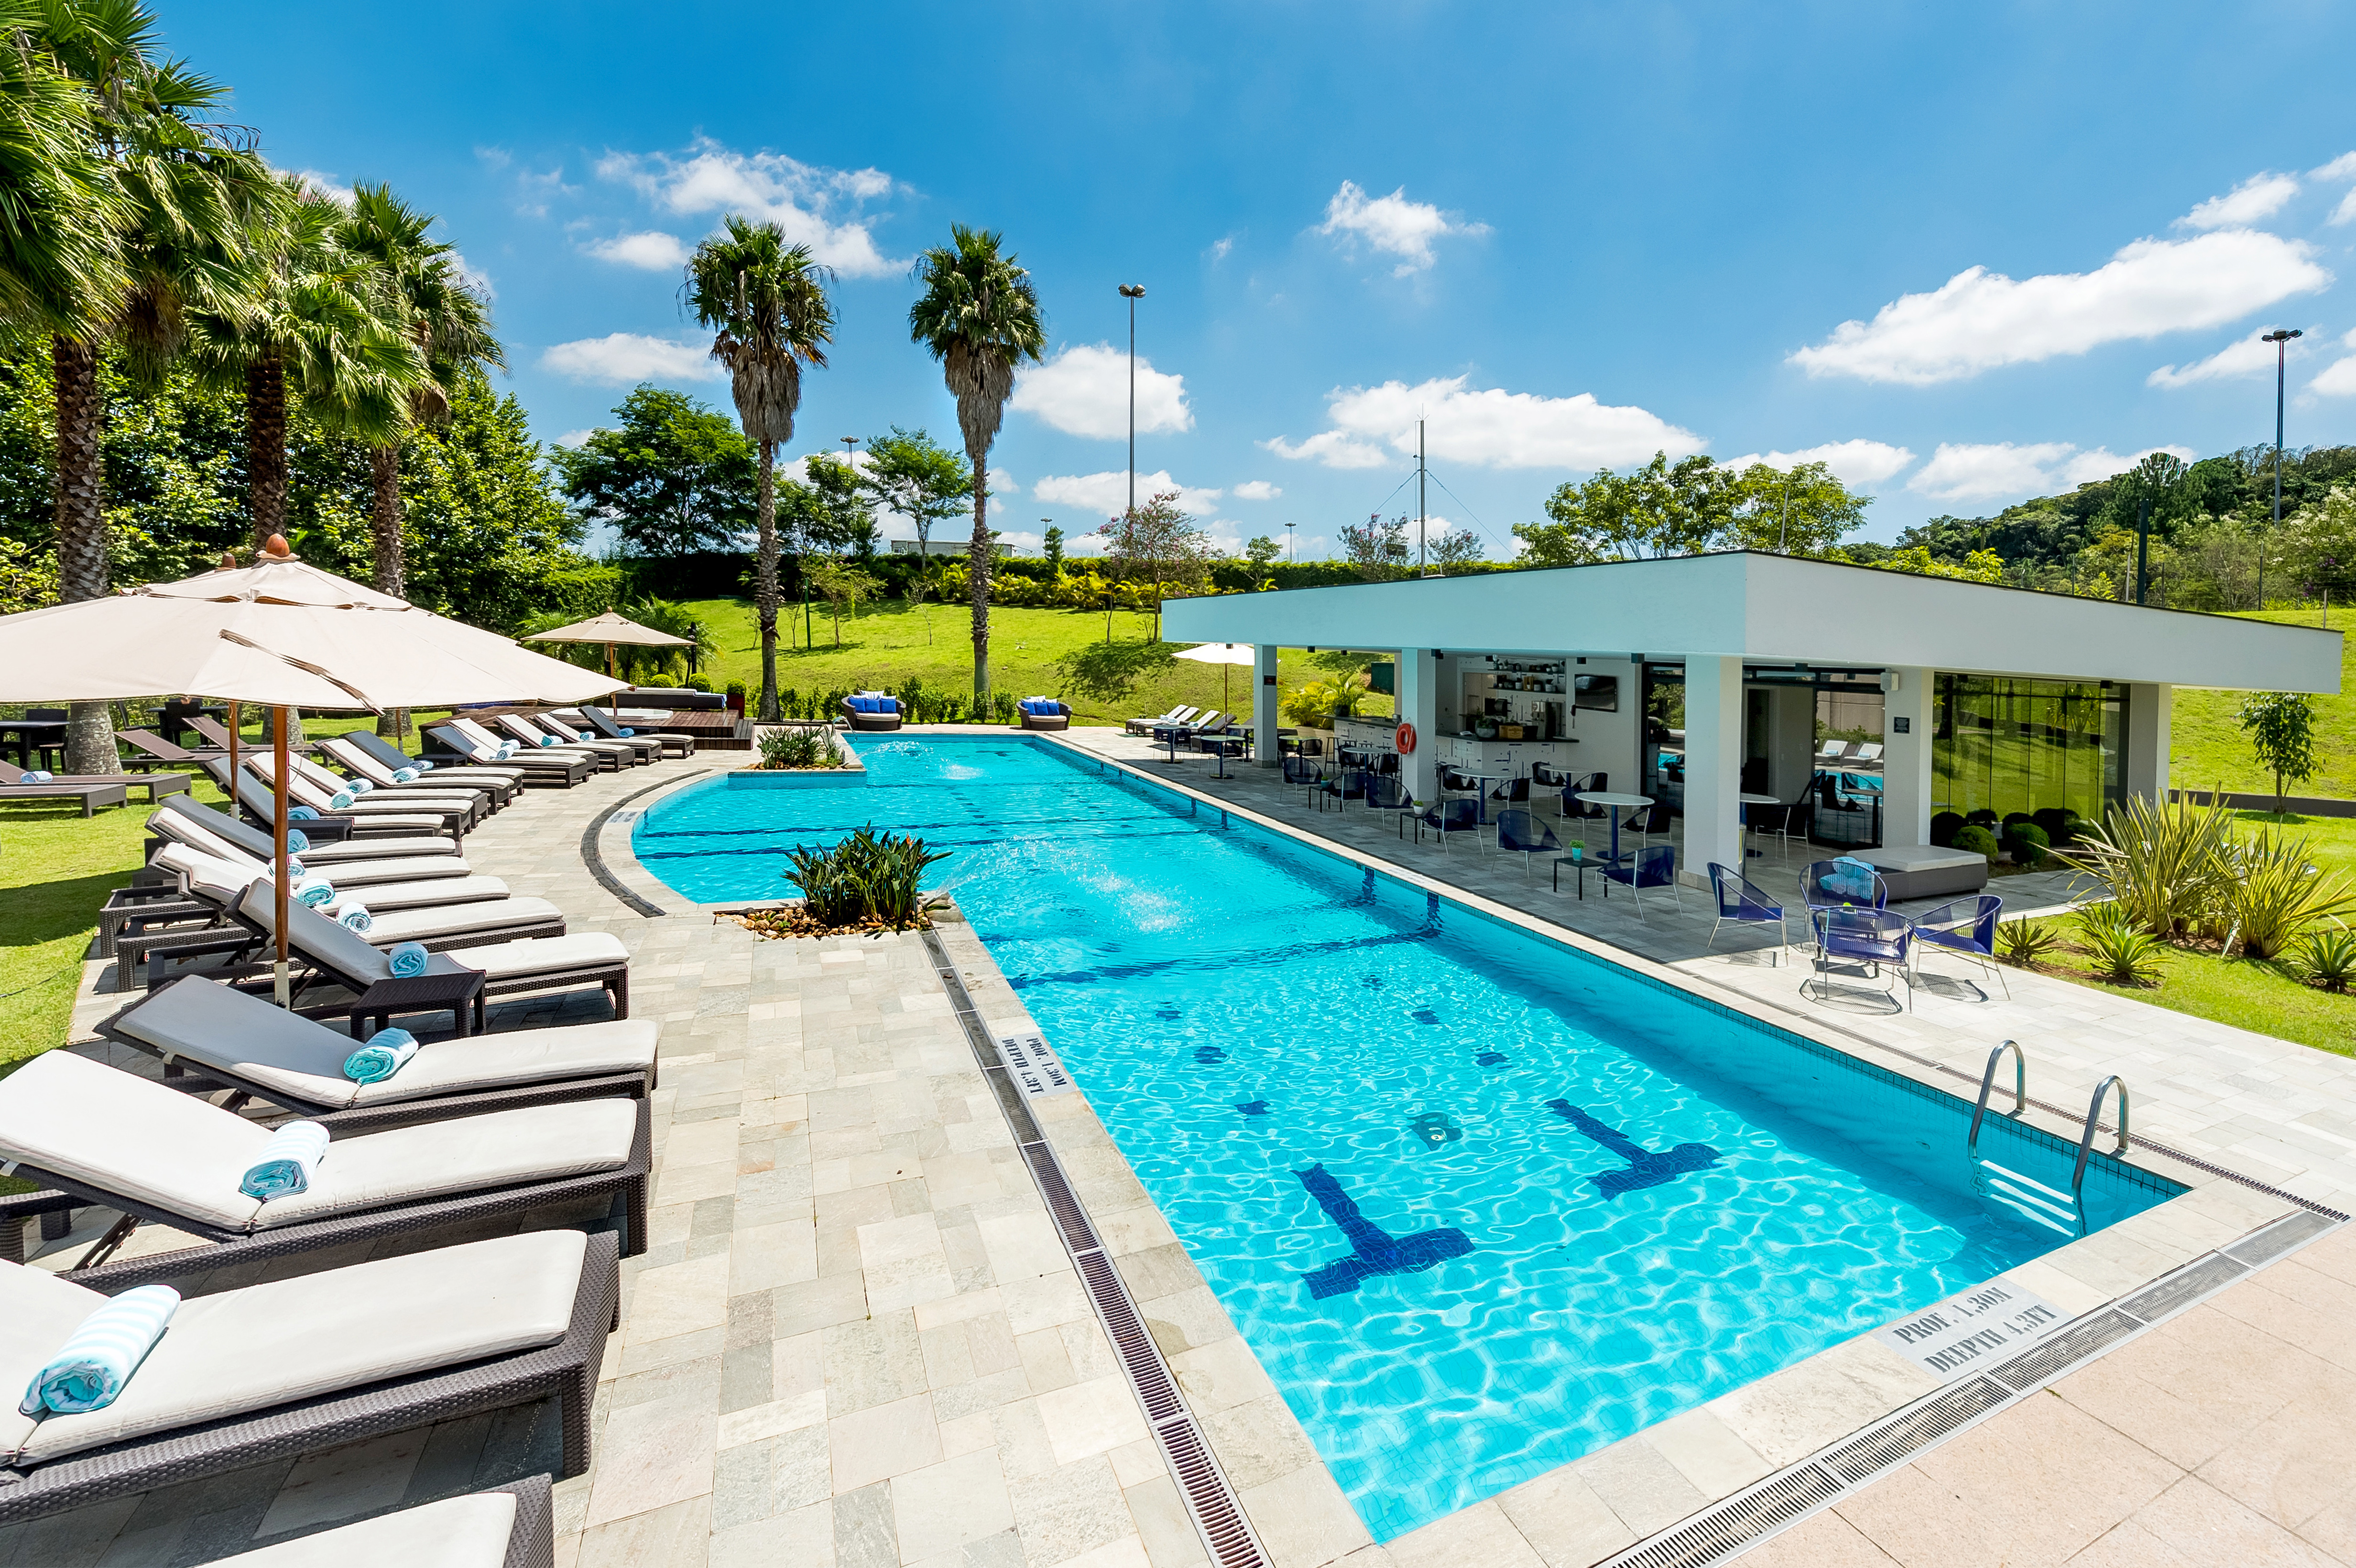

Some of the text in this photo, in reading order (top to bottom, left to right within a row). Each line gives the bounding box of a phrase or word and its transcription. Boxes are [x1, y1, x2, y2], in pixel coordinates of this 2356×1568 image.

[1002, 1039, 1045, 1093] DEEPTH 4,3FT
[1041, 1062, 1067, 1087] 1,30M
[1952, 1287, 2013, 1318] 1,30M
[1923, 1304, 2057, 1373] DEEPTH 4,3FT
